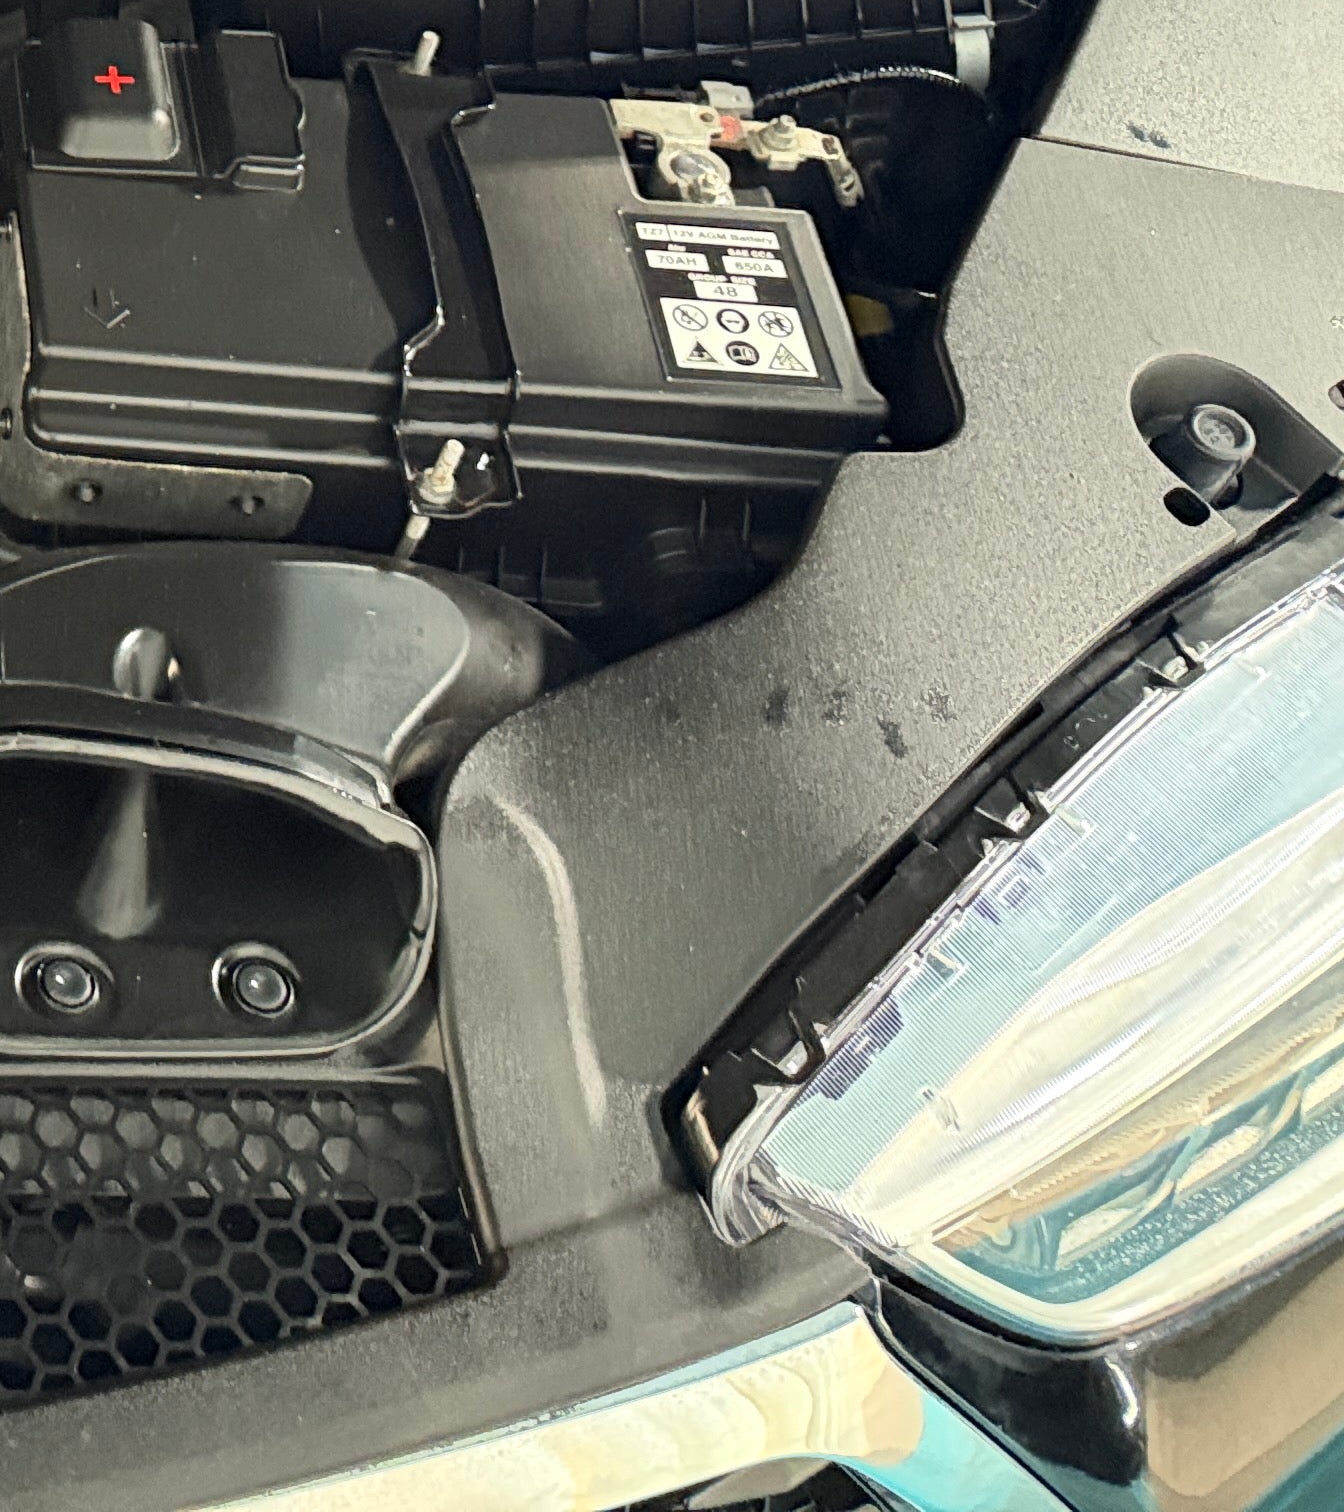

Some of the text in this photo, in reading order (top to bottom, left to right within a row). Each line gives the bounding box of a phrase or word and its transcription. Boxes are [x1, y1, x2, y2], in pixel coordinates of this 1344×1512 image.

[673, 230, 774, 245] 12V AGM Battery
[657, 255, 697, 266] 70AH
[713, 285, 738, 297] 48
